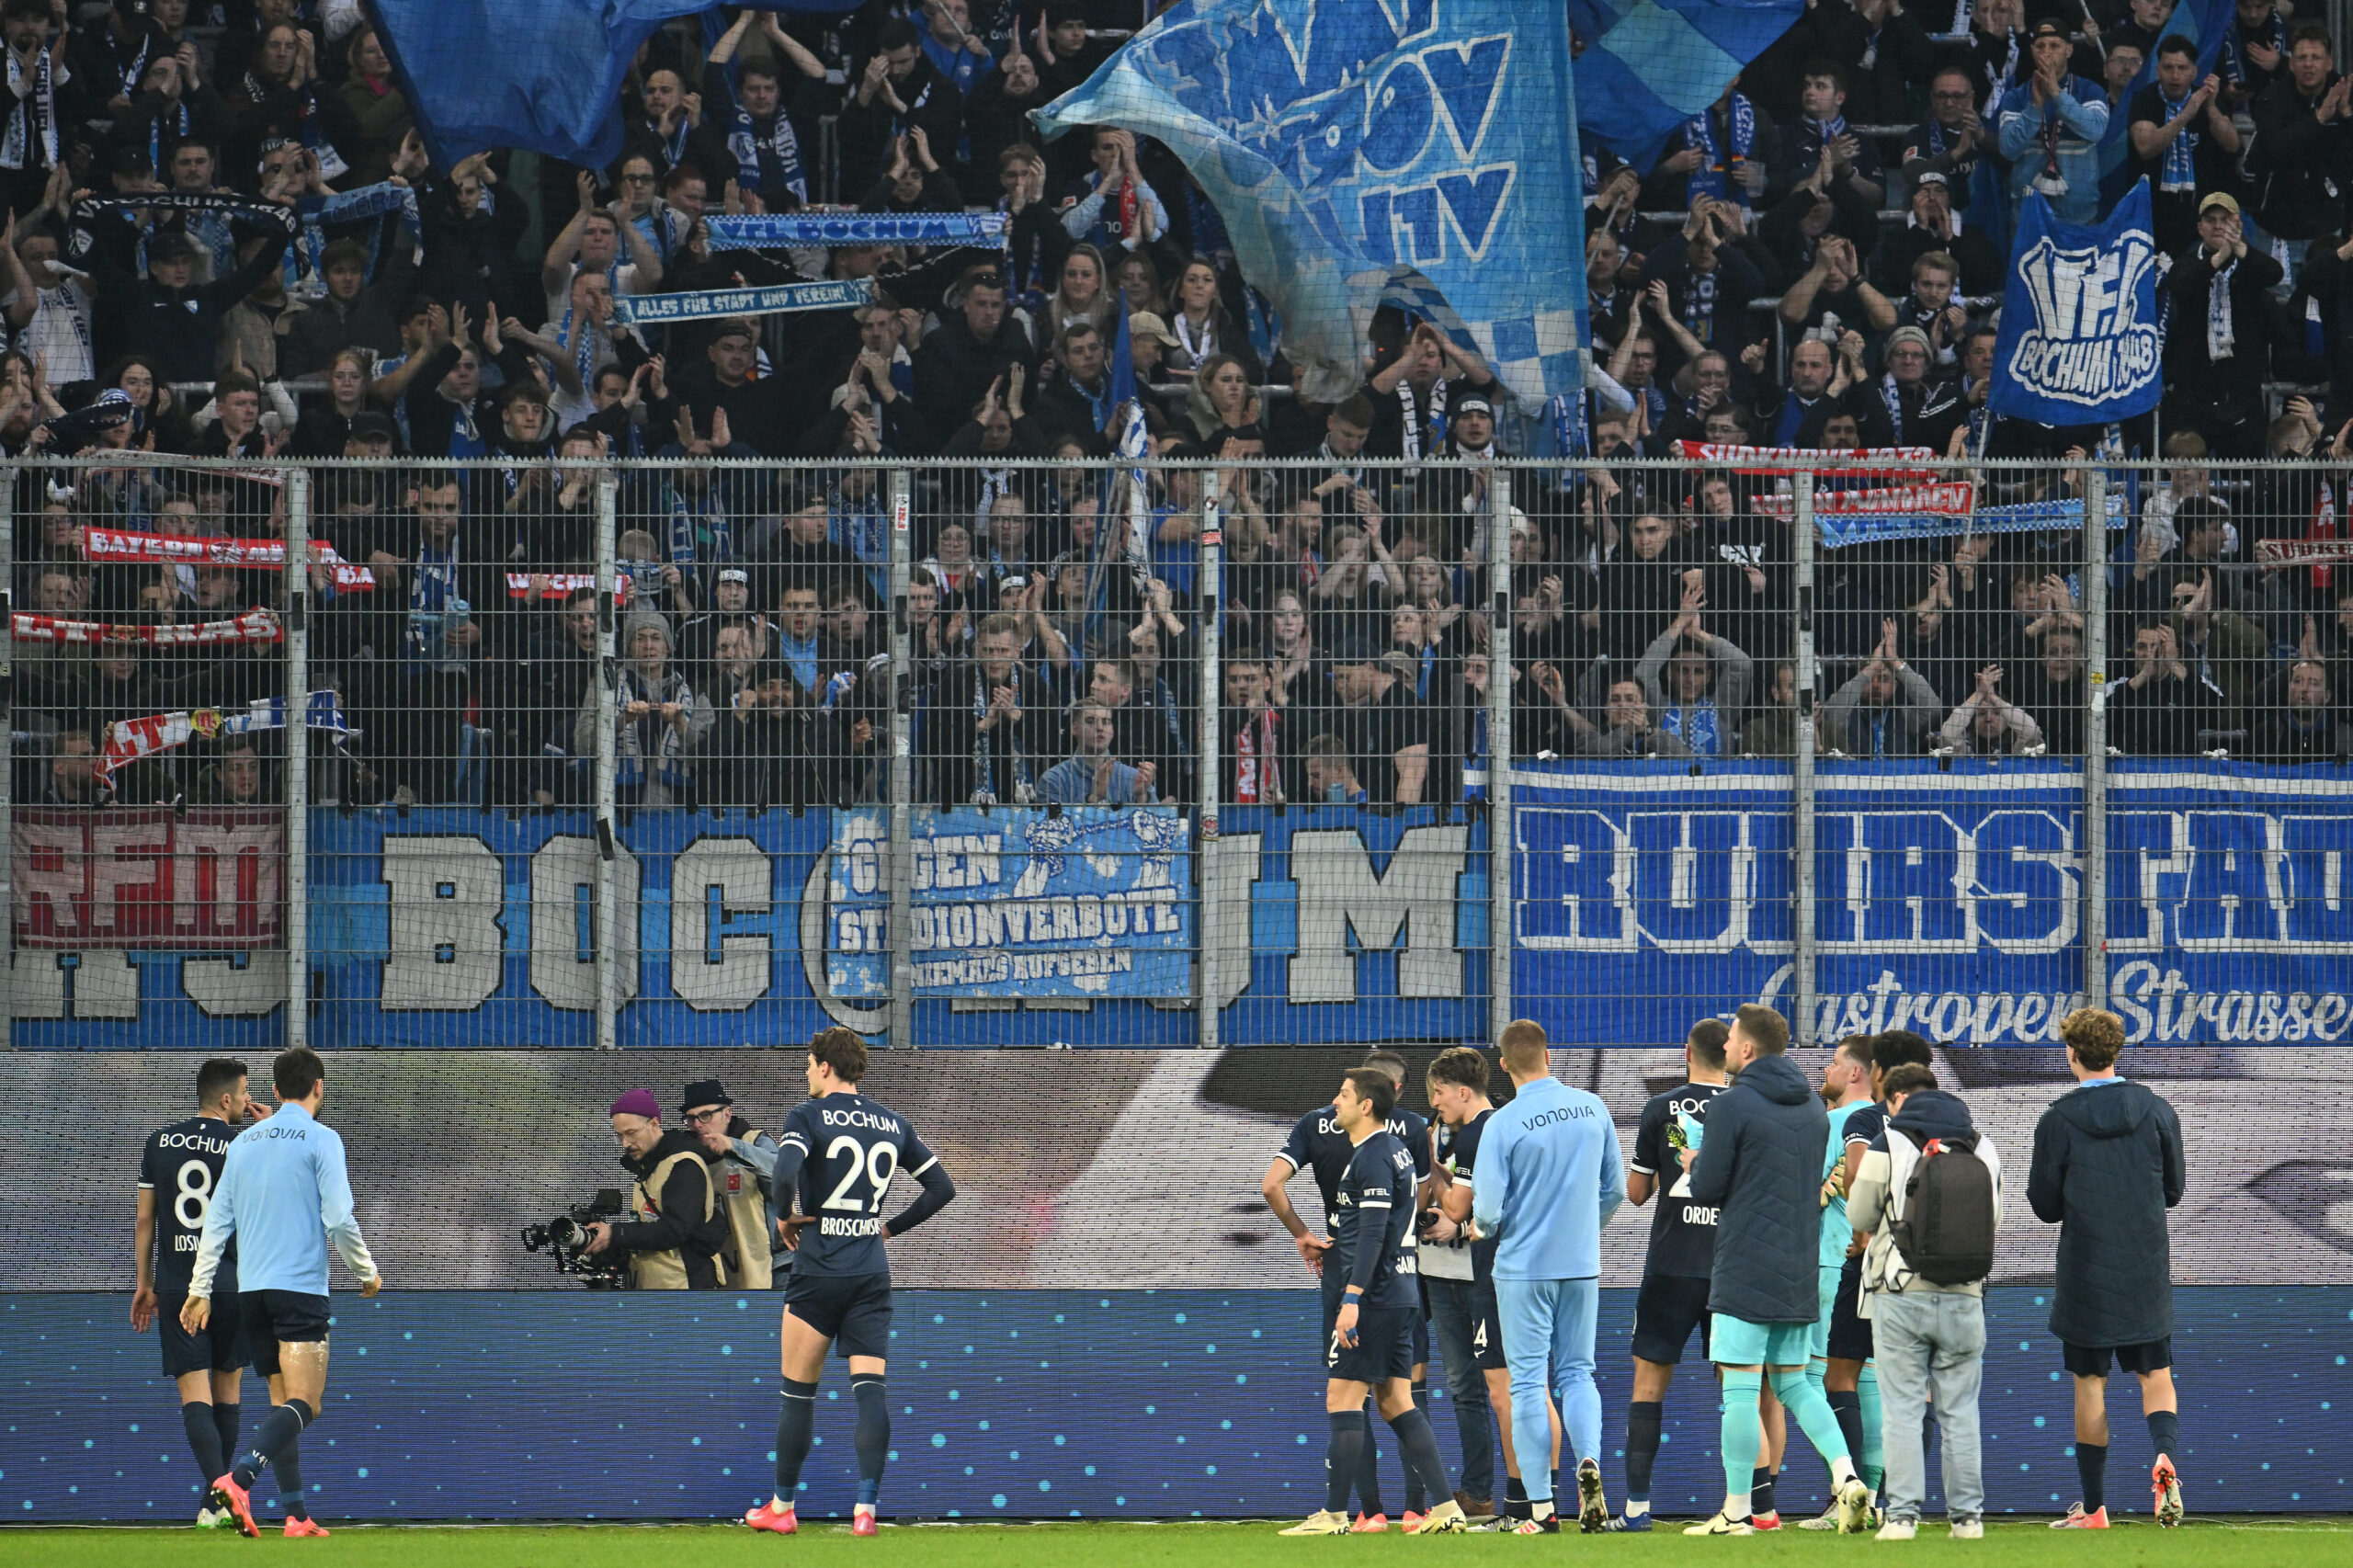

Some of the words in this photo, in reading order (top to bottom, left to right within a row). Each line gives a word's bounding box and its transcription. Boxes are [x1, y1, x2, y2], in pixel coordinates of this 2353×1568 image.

[796, 219, 952, 241] BOCHUM
[637, 298, 679, 317] ALLES
[682, 296, 710, 314] FÜR
[713, 294, 756, 312] STADT
[759, 290, 788, 307] UND
[2018, 335, 2114, 395] BOCHUM
[2113, 331, 2154, 389] 1848
[2111, 960, 2353, 1043] Strasse
[822, 1109, 901, 1134] BOCHUM
[175, 1160, 211, 1229] 8
[821, 1135, 898, 1213] 29
